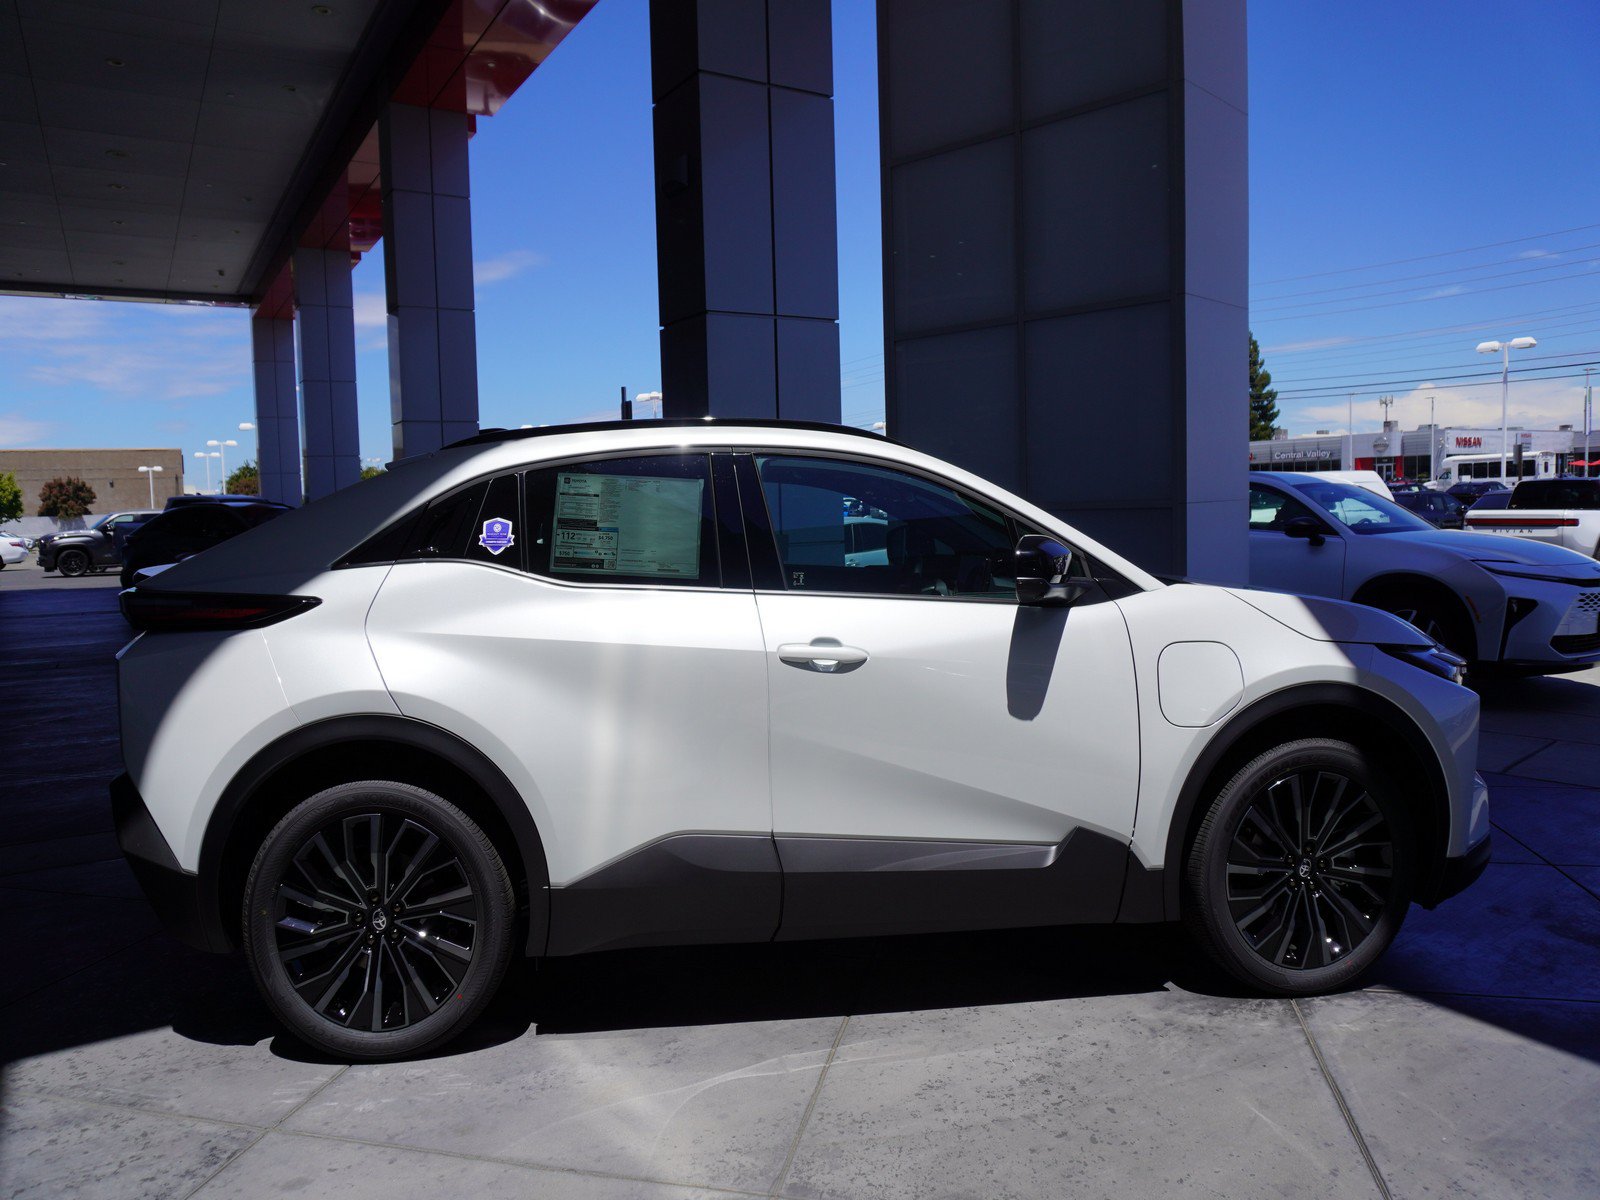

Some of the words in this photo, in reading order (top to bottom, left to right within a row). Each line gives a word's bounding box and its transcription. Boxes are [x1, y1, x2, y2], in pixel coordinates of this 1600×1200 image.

[1456, 437, 1482, 448] NISSAN
[1275, 451, 1304, 459] Central
[1307, 450, 1331, 459] Valley
[561, 532, 576, 540] 112
